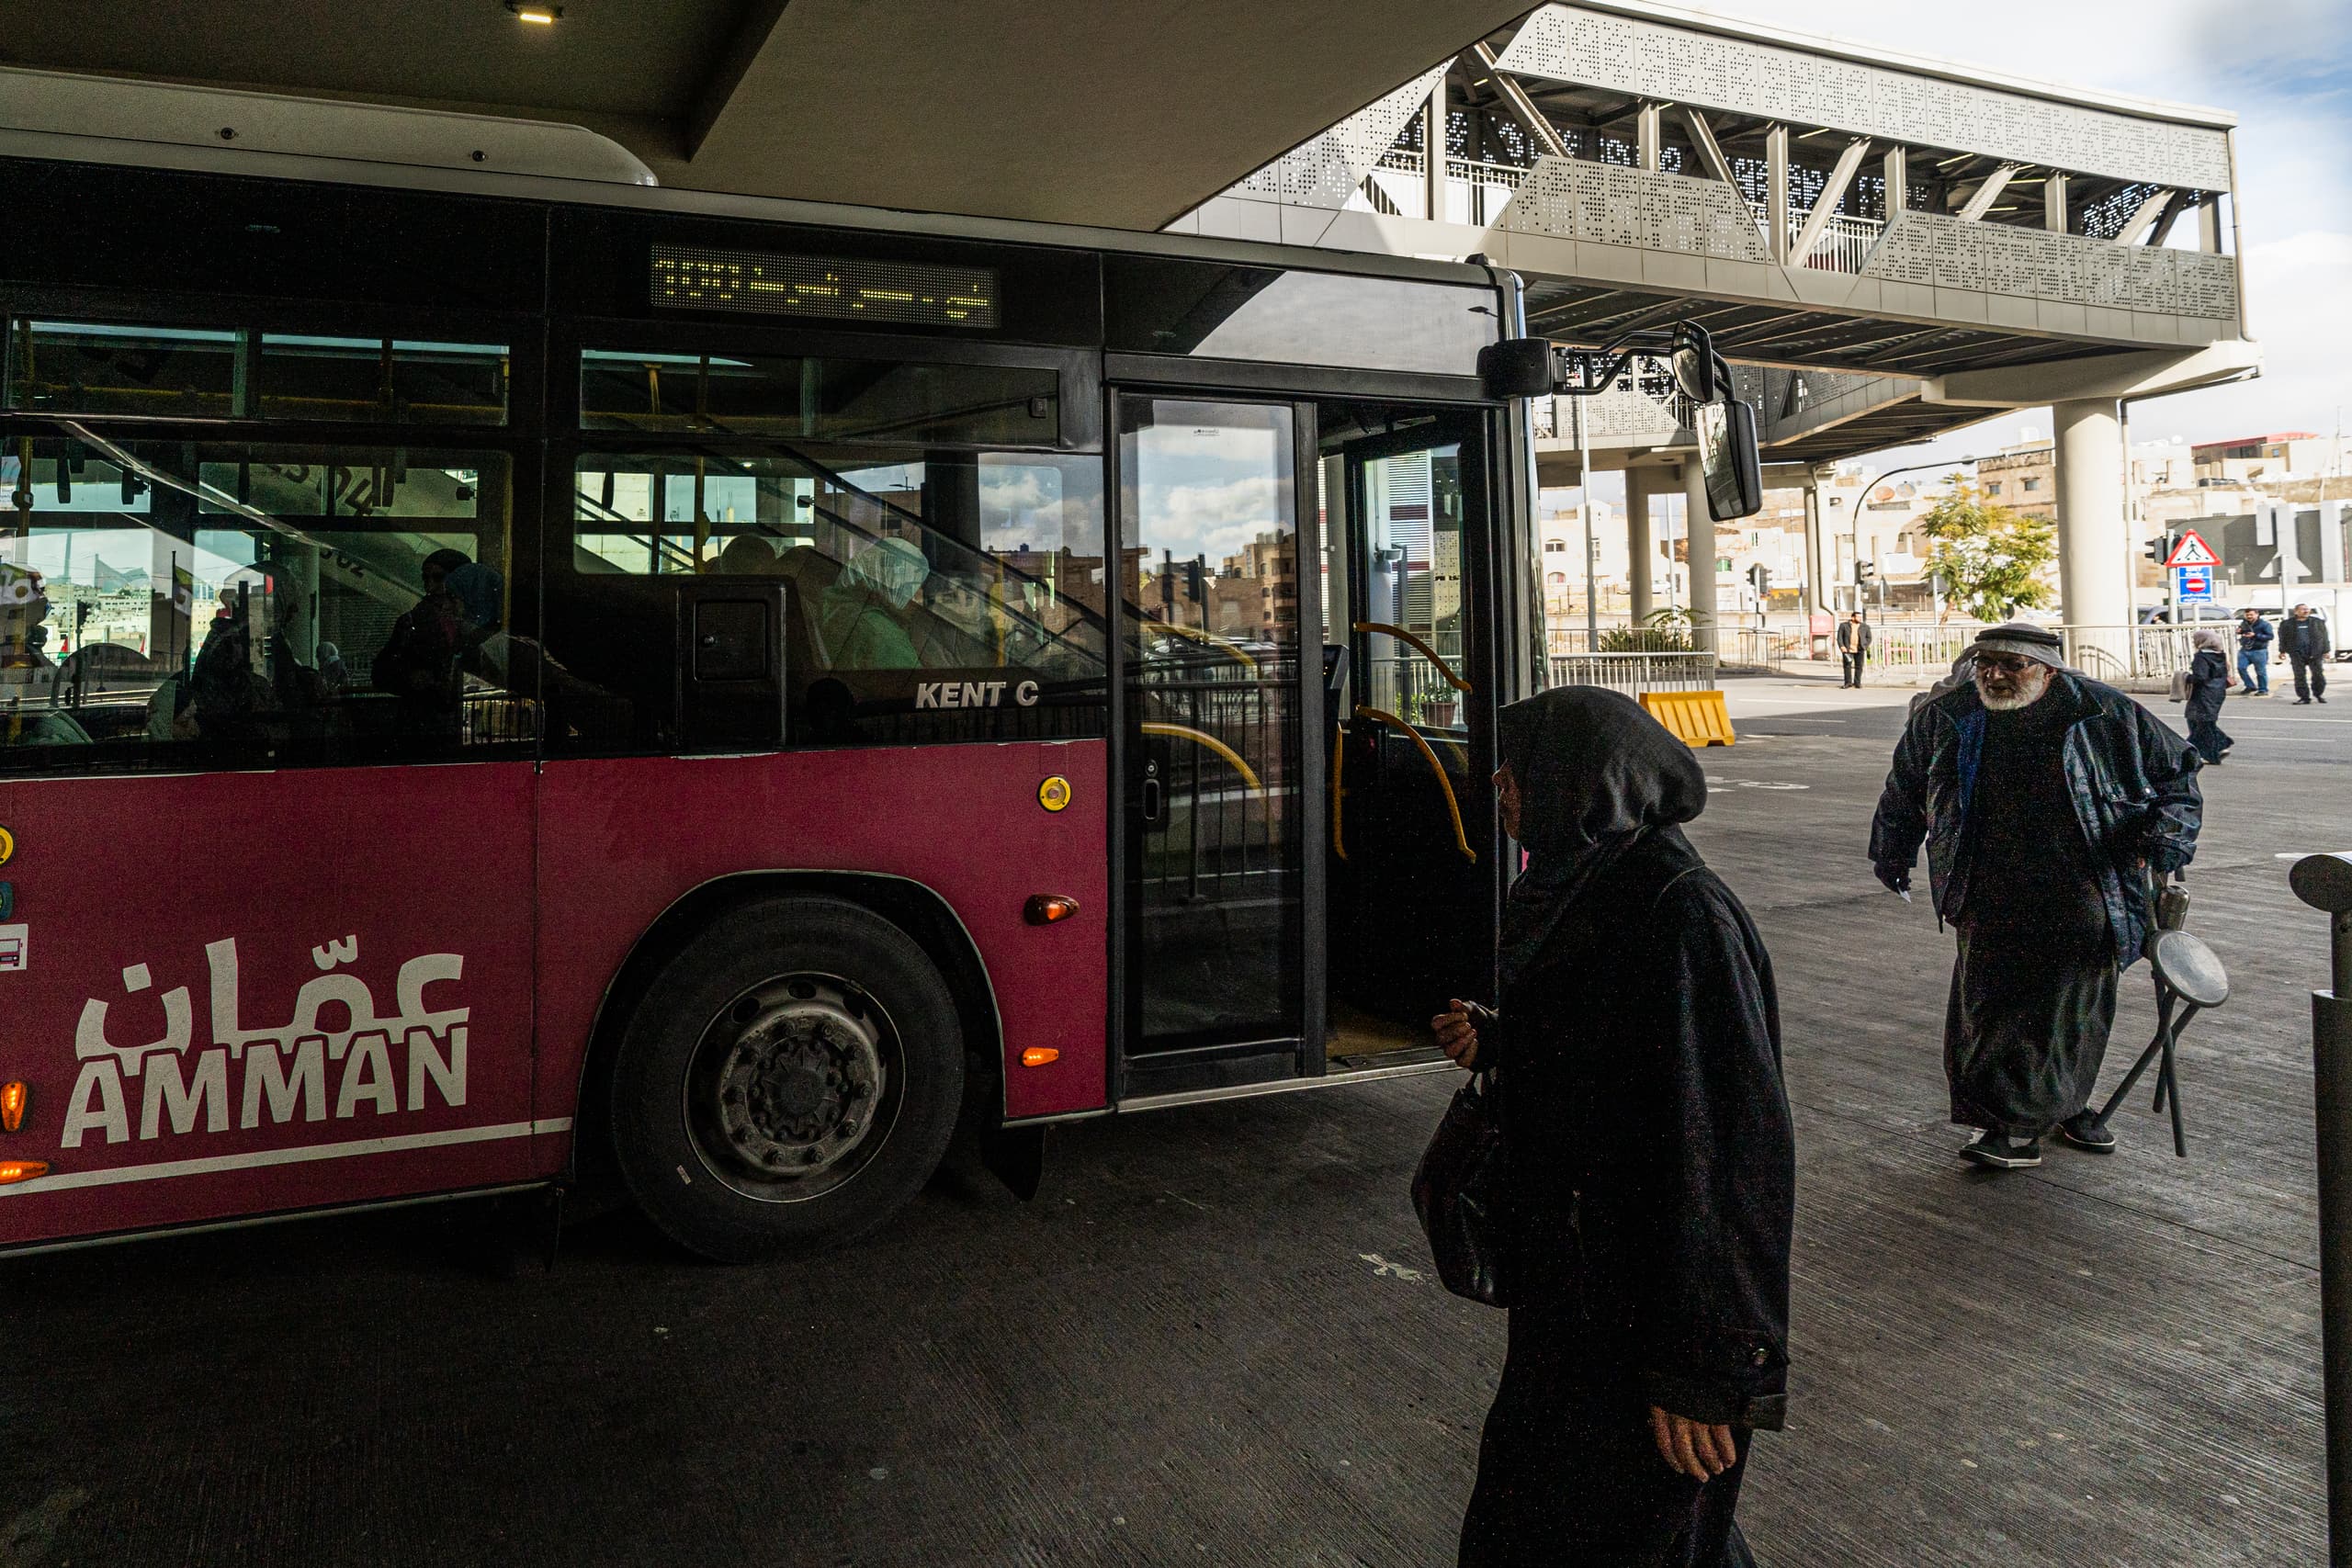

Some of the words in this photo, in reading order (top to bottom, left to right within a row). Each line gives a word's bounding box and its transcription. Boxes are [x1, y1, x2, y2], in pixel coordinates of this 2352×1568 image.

[915, 681, 1007, 709] KENT
[1015, 680, 1039, 706] C
[60, 1026, 469, 1148] AMMAN
